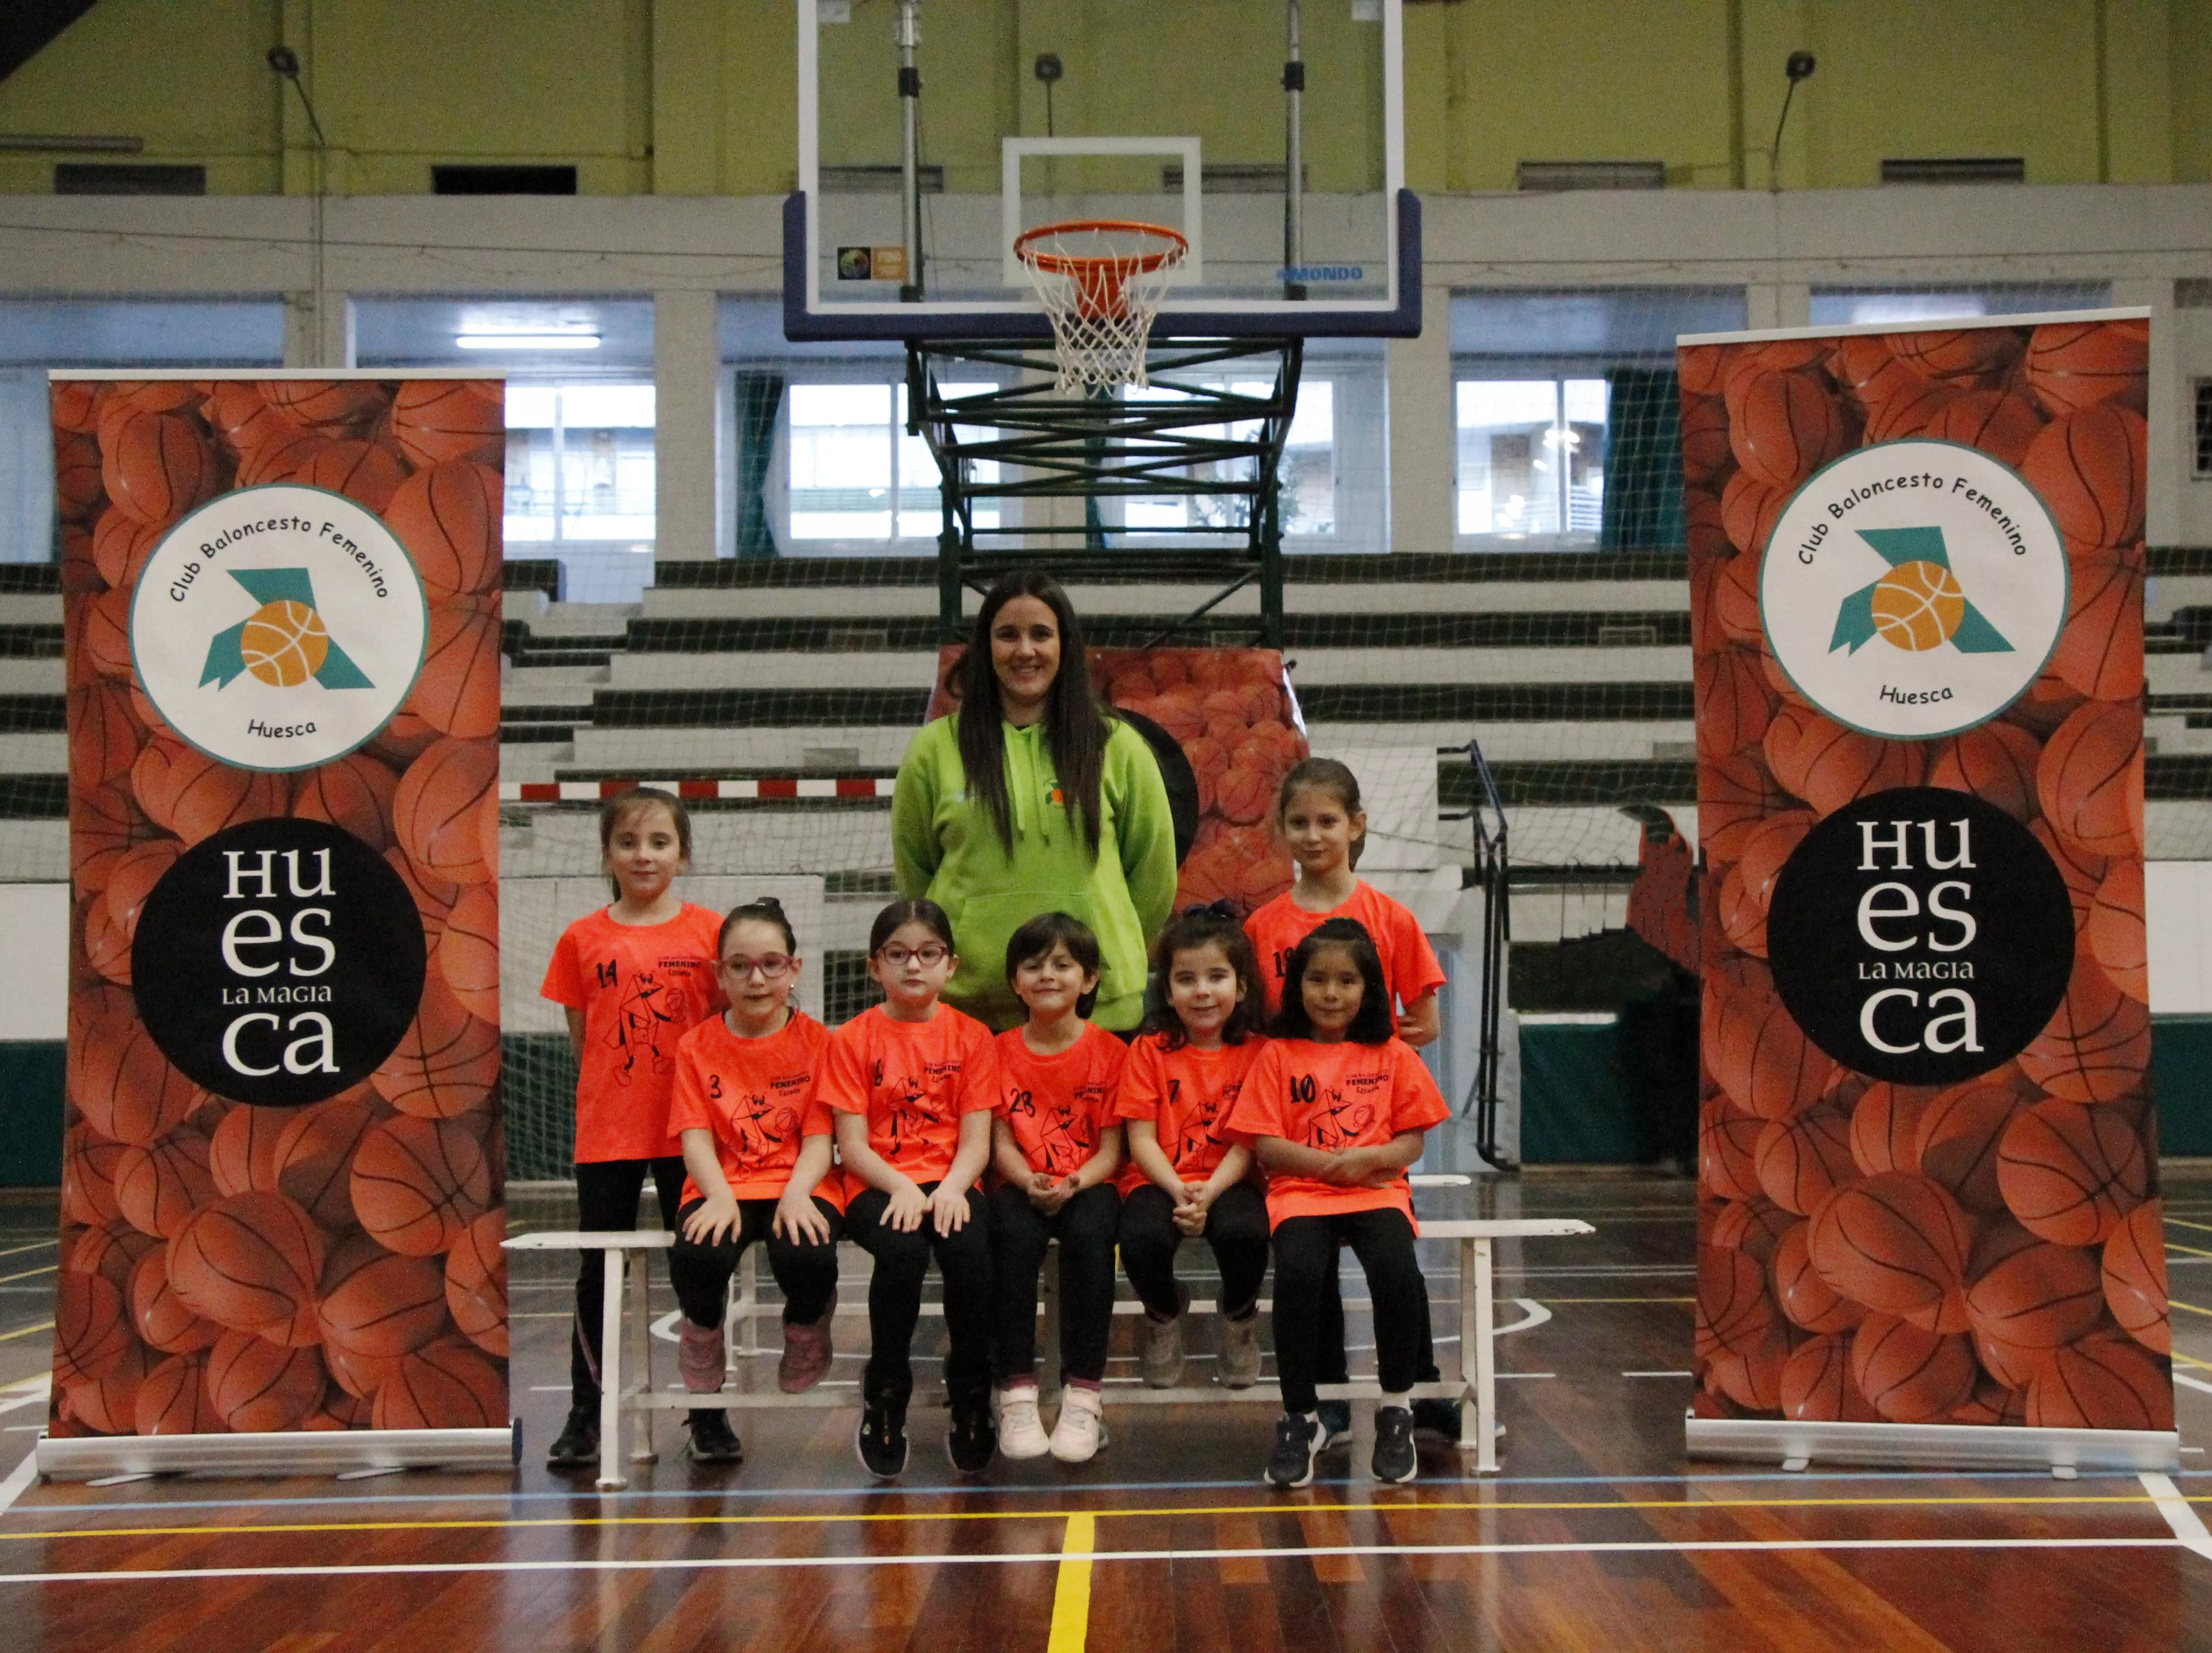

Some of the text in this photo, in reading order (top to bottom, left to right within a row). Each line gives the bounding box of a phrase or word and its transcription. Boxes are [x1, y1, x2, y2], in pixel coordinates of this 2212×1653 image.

[1282, 267, 1363, 280] MONDO
[1799, 472, 2026, 564] Club Baloncesto Femenino
[170, 517, 387, 602] Club Baloncesto Femenino
[1879, 684, 1953, 705] Huesca
[248, 719, 316, 738] Huesca
[1857, 818, 1976, 871] Hu
[222, 847, 336, 898] Hu
[597, 959, 618, 988] 14
[709, 1074, 722, 1099] 3
[1167, 1079, 1181, 1106] 7
[1290, 1074, 1316, 1103] 10
[1346, 1074, 1389, 1086] FEMENINO
